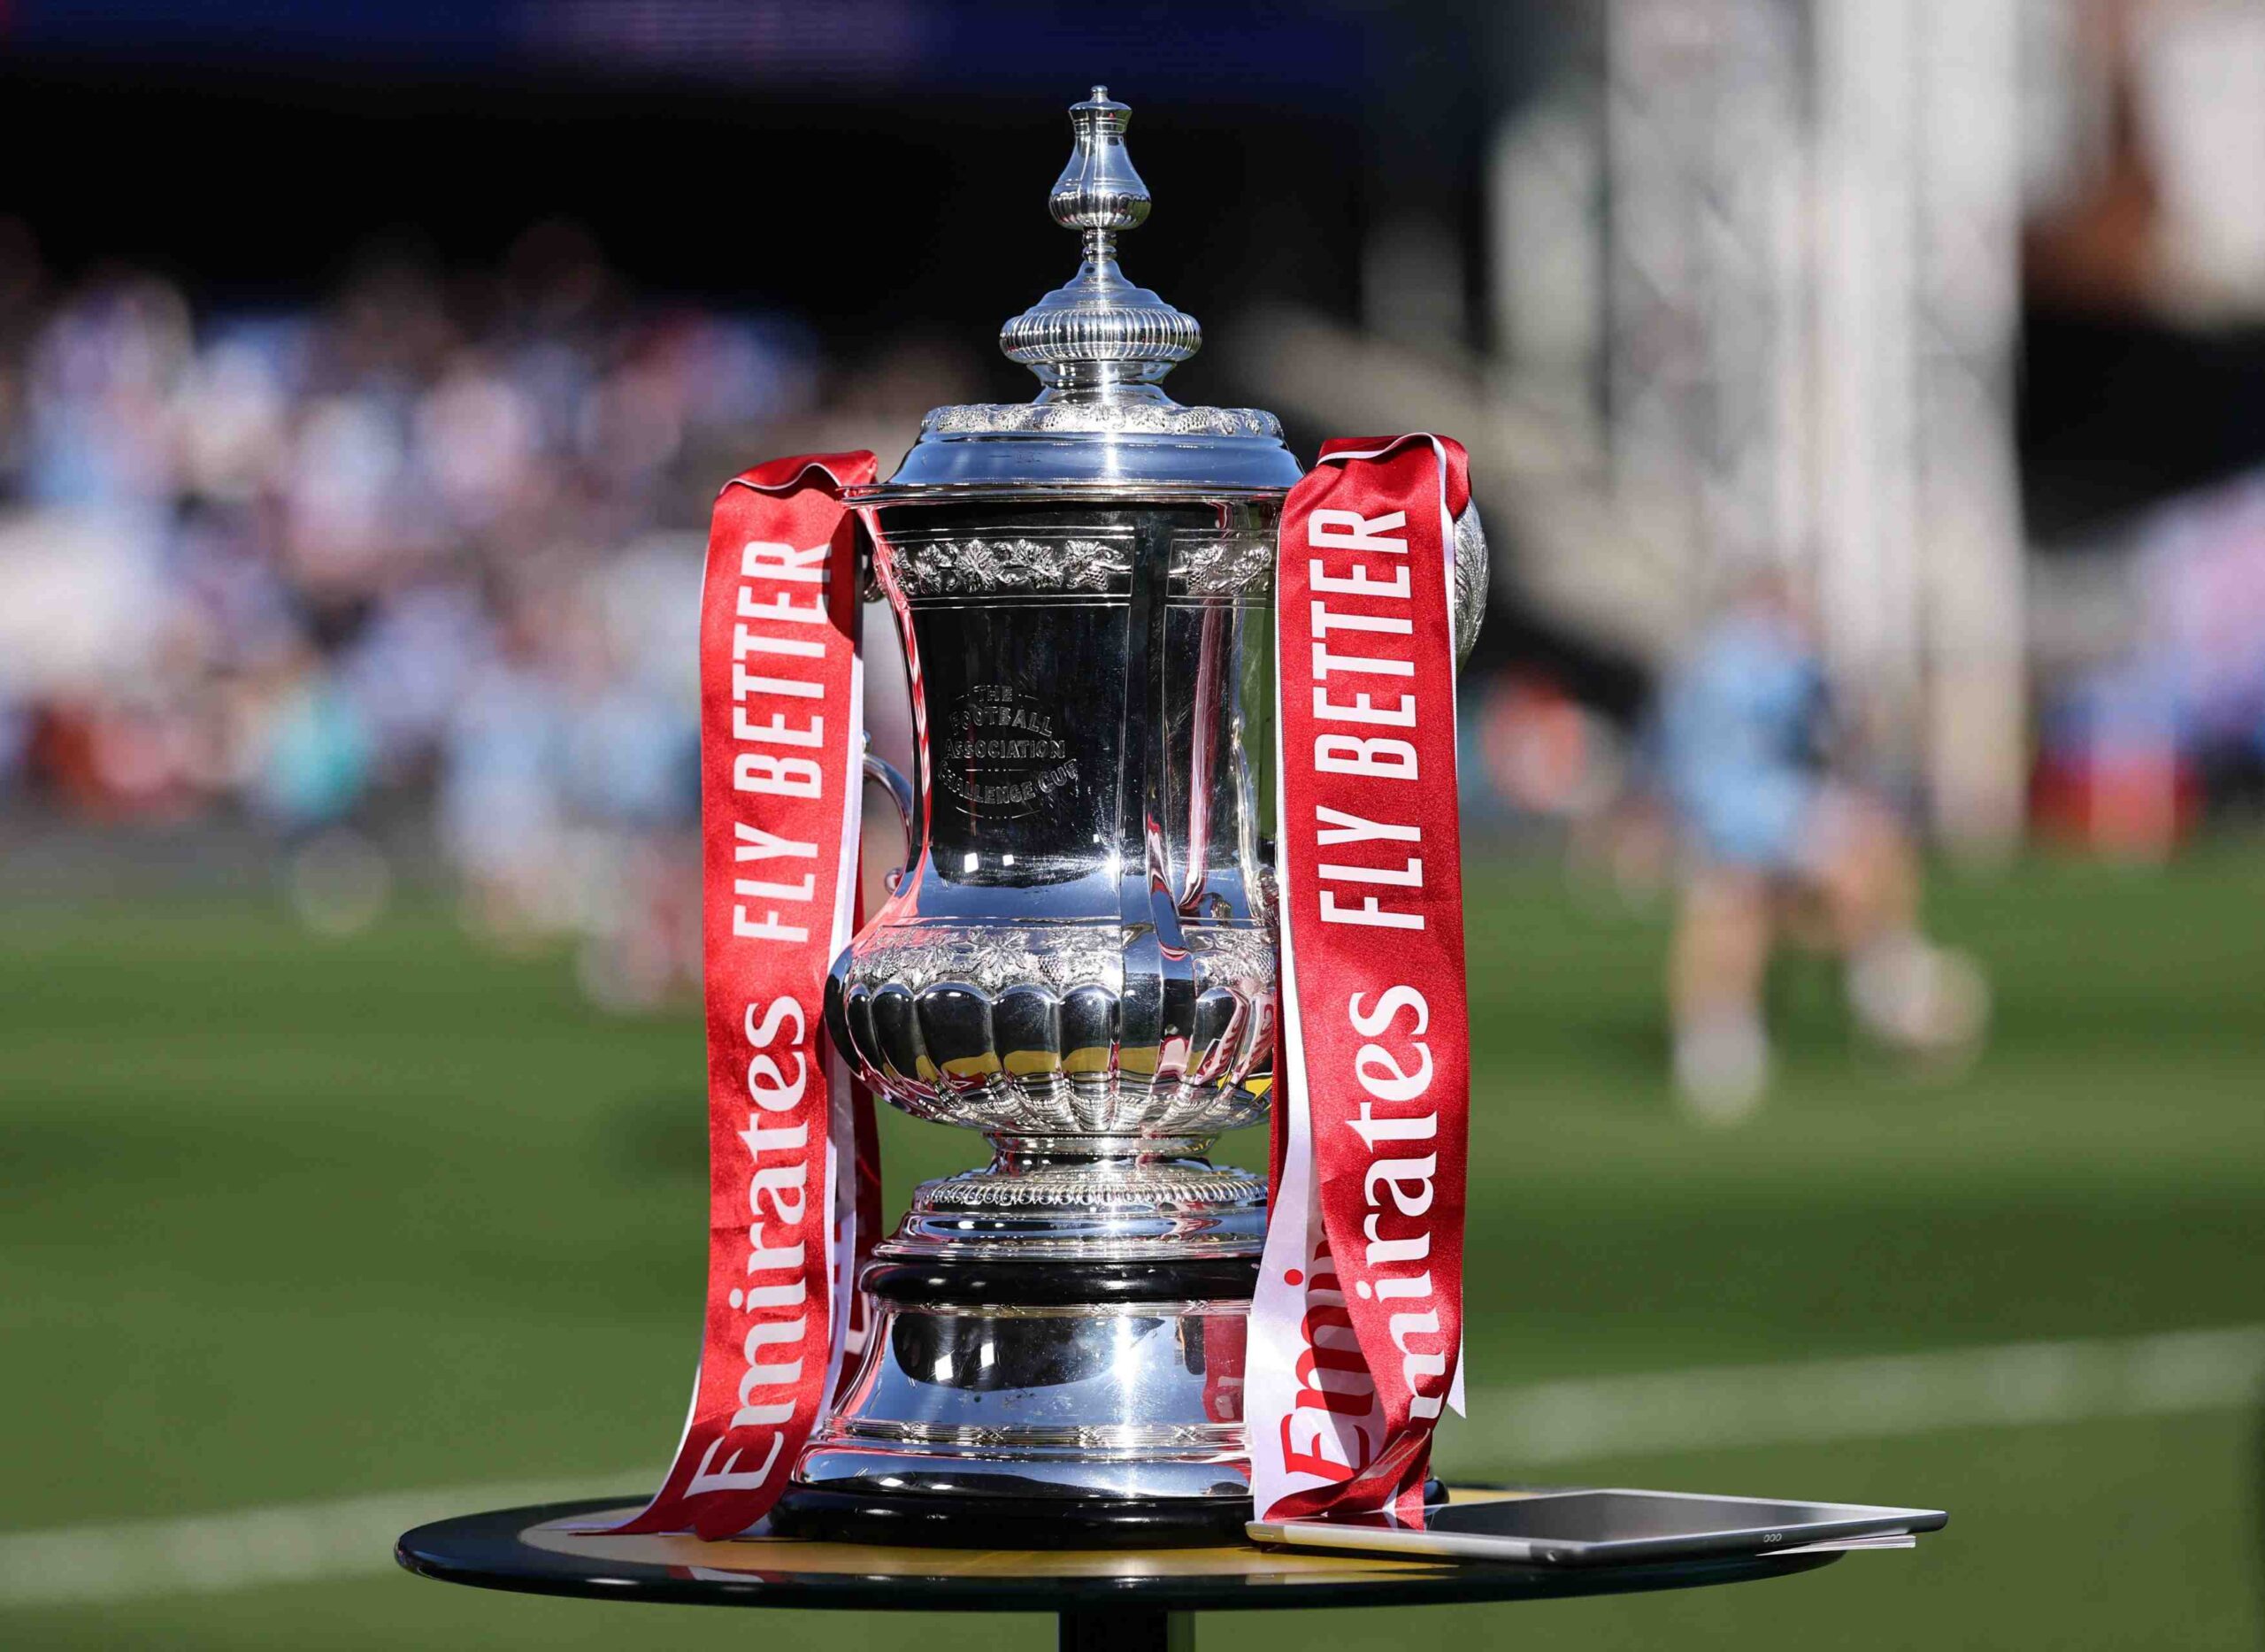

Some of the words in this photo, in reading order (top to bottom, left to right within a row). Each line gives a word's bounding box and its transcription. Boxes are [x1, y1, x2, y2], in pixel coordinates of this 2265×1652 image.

[733, 541, 832, 800] BETTER
[973, 684, 1013, 703] THE
[1308, 508, 1419, 780] BETTER
[937, 759, 1037, 804] CHALLENGE
[1038, 757, 1079, 794] CUP
[943, 737, 1066, 759] ASSOCIATION
[948, 705, 1053, 738] FOOTBALL
[733, 822, 818, 943] FLY
[1316, 804, 1426, 931] FLY
[682, 995, 810, 1502] Emirates
